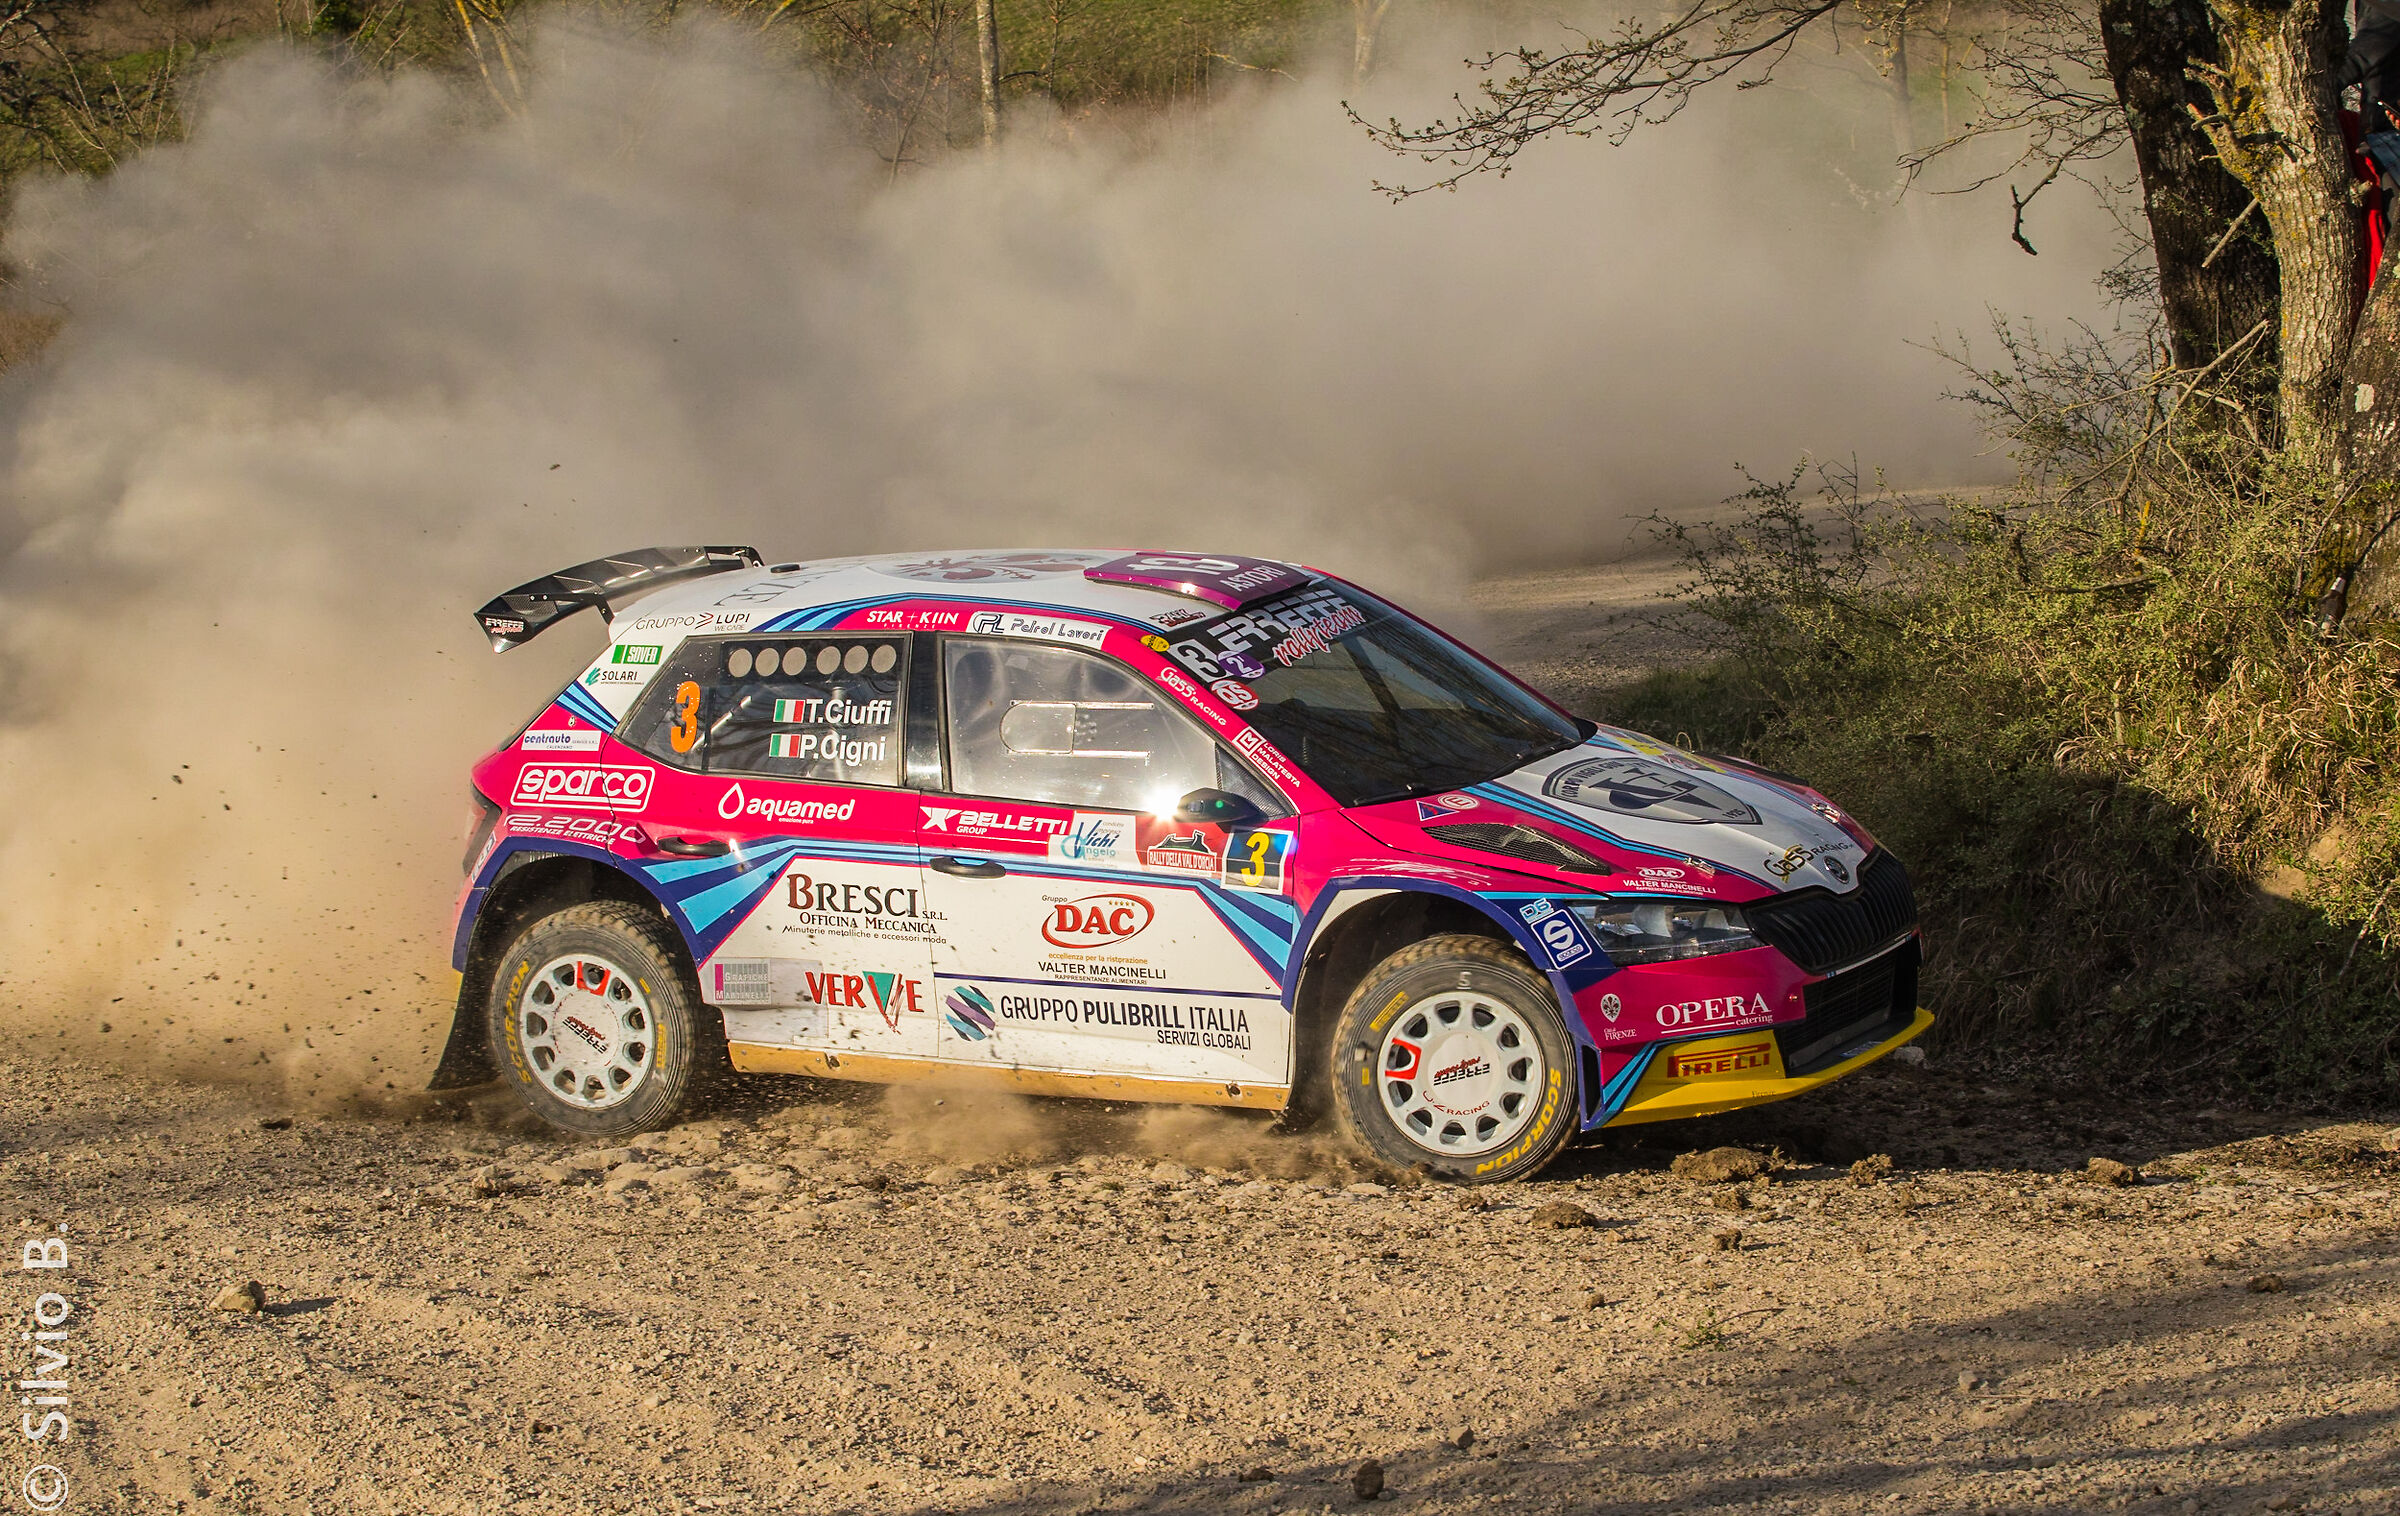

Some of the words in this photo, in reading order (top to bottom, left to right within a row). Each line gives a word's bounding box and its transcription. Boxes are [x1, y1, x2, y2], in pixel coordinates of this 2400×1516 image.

[1219, 565, 1287, 592] ASTORI
[636, 616, 695, 630] GRUPPO
[716, 612, 750, 624] LUPI
[866, 610, 904, 622] STAR
[920, 612, 960, 624] KIIN
[1058, 623, 1104, 641] Lavori
[627, 646, 658, 664] SOVER
[1178, 645, 1227, 678] 3
[602, 670, 638, 681] SOLARI
[670, 680, 700, 754] 3
[806, 698, 892, 725] T.Ciuffi
[1190, 696, 1226, 726] RACING
[524, 733, 570, 744] centrauto
[798, 733, 886, 766] P.Cigni
[1263, 742, 1286, 763] LORIS
[1252, 754, 1281, 780] DESIGN
[1258, 748, 1301, 788] MALATESTA
[522, 768, 647, 802] sparco
[746, 798, 856, 822] aquamed
[510, 825, 564, 836] RESISTENZE
[956, 825, 988, 835] GROUP
[960, 810, 1068, 834] BELLETTI
[1074, 819, 1120, 858] Vichi
[1150, 852, 1165, 865] RALLY
[1166, 852, 1182, 867] DELLA
[1182, 854, 1192, 868] VAL
[1241, 832, 1270, 887] 3
[1643, 868, 1678, 878] DAC
[786, 874, 918, 918] BRESCI
[922, 910, 948, 920] S.R.L.
[1622, 880, 1659, 888] VALTER
[1660, 882, 1716, 894] MANCINELLI
[1042, 894, 1068, 903] Gruppo
[800, 912, 858, 928] OFFICINA
[865, 916, 936, 934] MECCANICA
[1054, 904, 1135, 936] DAC
[782, 925, 826, 934] Minuterie
[828, 928, 871, 938] metalliche
[882, 932, 920, 942] accessori
[922, 936, 947, 944] moda
[1048, 952, 1084, 960] eccellenza
[1085, 954, 1097, 962] per
[1098, 954, 1104, 962] la
[724, 972, 768, 982] GRAFICHE
[1038, 962, 1086, 974] VALTER
[1090, 964, 1166, 980] MANCINELLI
[1054, 974, 1110, 983] RAPPRESENTANZE
[1000, 996, 1078, 1023] GRUPPO
[1084, 1002, 1185, 1030] PULIBRILL
[1188, 1006, 1249, 1033] ITALIA
[1656, 992, 1772, 1027] OPERA
[1736, 1014, 1774, 1026] catering
[504, 960, 532, 1084] SCORPION
[1156, 1030, 1200, 1046] SERVIZI
[1202, 1034, 1251, 1050] GLOBALI
[1604, 1029, 1637, 1041] FIRENZE
[1667, 1043, 1772, 1078] PIRELLI
[1446, 1101, 1490, 1116] RACING
[1476, 1067, 1562, 1176] SCORPION
